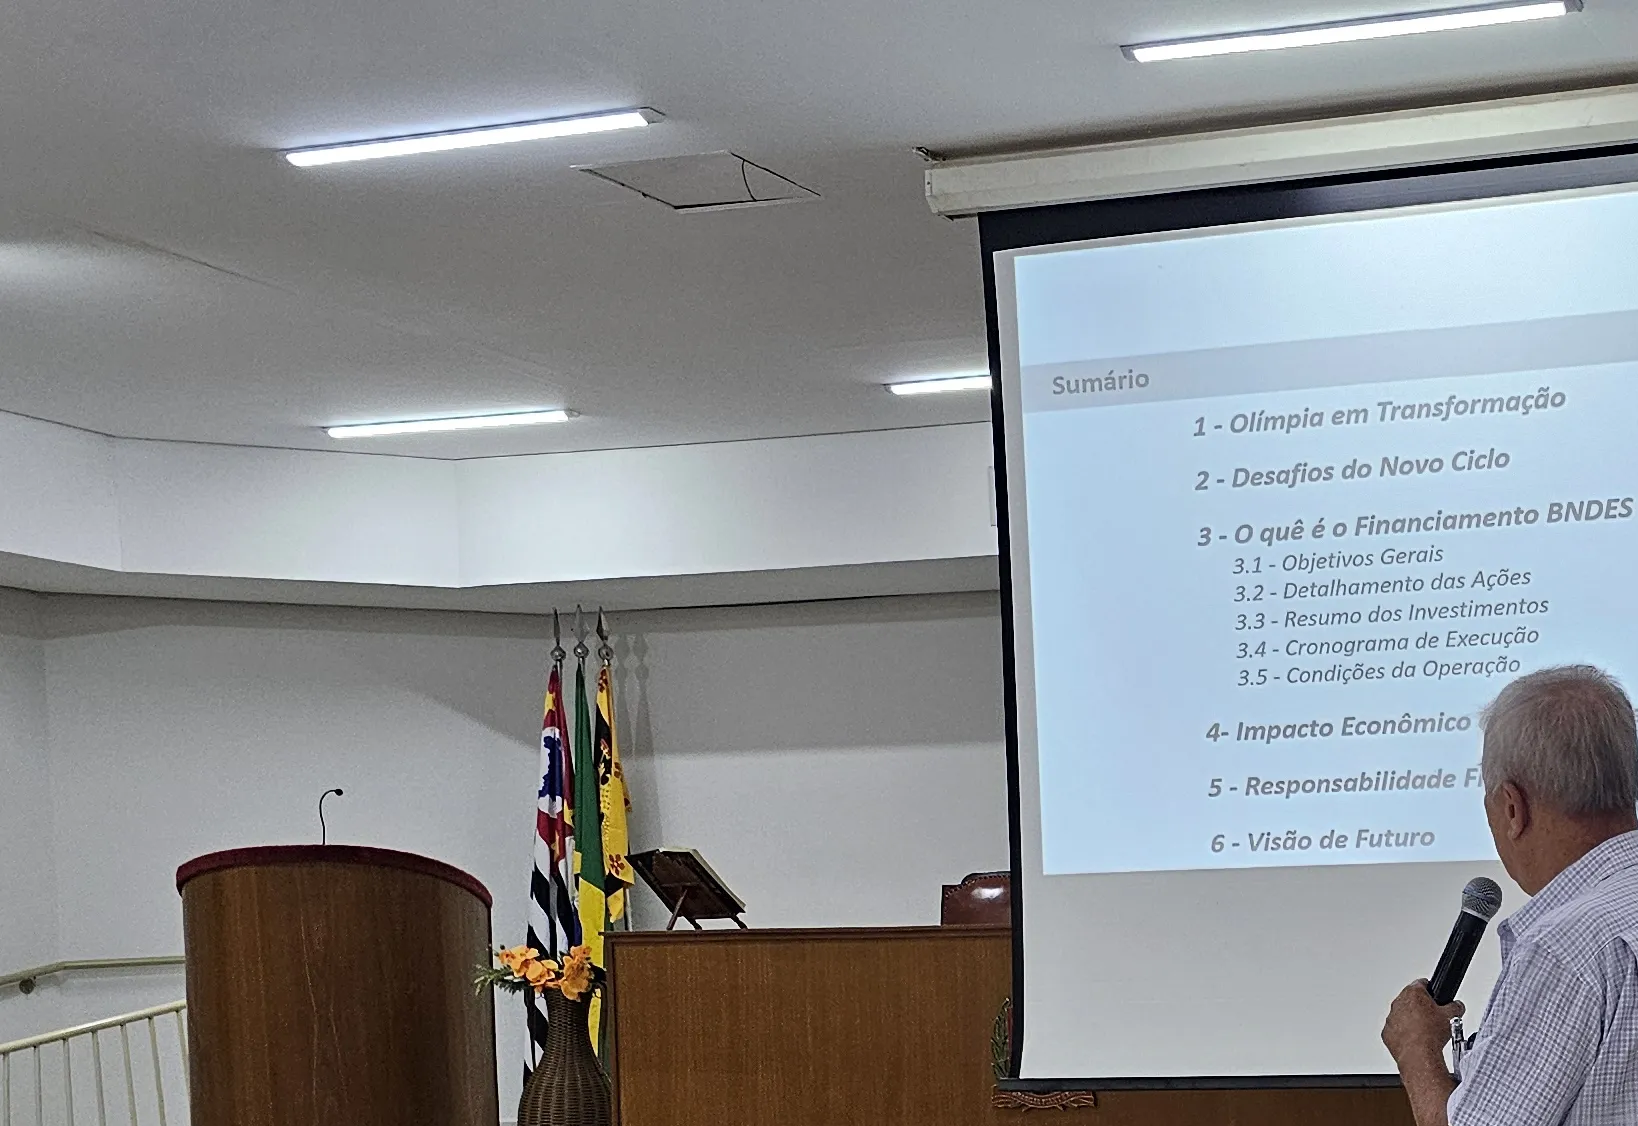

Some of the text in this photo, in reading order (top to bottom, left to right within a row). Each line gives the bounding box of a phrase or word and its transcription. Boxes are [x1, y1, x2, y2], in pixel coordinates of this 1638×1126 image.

[1052, 368, 1150, 395] Sumário
[1193, 417, 1206, 437] 1
[1230, 406, 1325, 435] Olímpia
[1331, 407, 1369, 426] em
[1377, 386, 1567, 422] Transformação
[1195, 470, 1210, 491] 2
[1232, 458, 1335, 489] Desafios
[1341, 457, 1373, 480] do
[1379, 455, 1445, 478] Novo
[1451, 447, 1511, 472] Ciclo
[1198, 526, 1212, 547] 3
[1234, 523, 1254, 545] O
[1259, 518, 1305, 547] quê
[1311, 517, 1326, 539] é
[1332, 522, 1348, 538] o
[1354, 506, 1540, 537] Financiamento
[1546, 497, 1634, 523] BNDES
[1232, 556, 1263, 575] 3.1
[1282, 551, 1374, 574] Objetivos
[1380, 545, 1444, 565] Gerais
[1233, 584, 1264, 602] 3.2
[1283, 576, 1425, 600] Detalhamento
[1430, 572, 1466, 590] das
[1470, 568, 1532, 591] Ações
[1235, 612, 1266, 631] 3.3
[1284, 610, 1362, 628] Resumo
[1368, 604, 1403, 623] dos
[1408, 598, 1549, 621] Investimentos
[1236, 641, 1267, 659] 3.4
[1285, 637, 1409, 657] Cronograma
[1415, 631, 1440, 650] de
[1445, 626, 1540, 649] Execução
[1237, 668, 1268, 687] 3.5
[1286, 662, 1386, 685] Condições
[1391, 660, 1416, 679] da
[1422, 655, 1521, 681] Operação
[1236, 719, 1334, 745] Impacto
[1341, 712, 1472, 737] Econômico
[1208, 778, 1222, 798] 5
[1245, 768, 1457, 800] Responsabilidade
[1210, 833, 1226, 854] 6
[1248, 829, 1313, 852] Visão
[1319, 829, 1349, 850] de
[1355, 828, 1436, 849] Futuro
